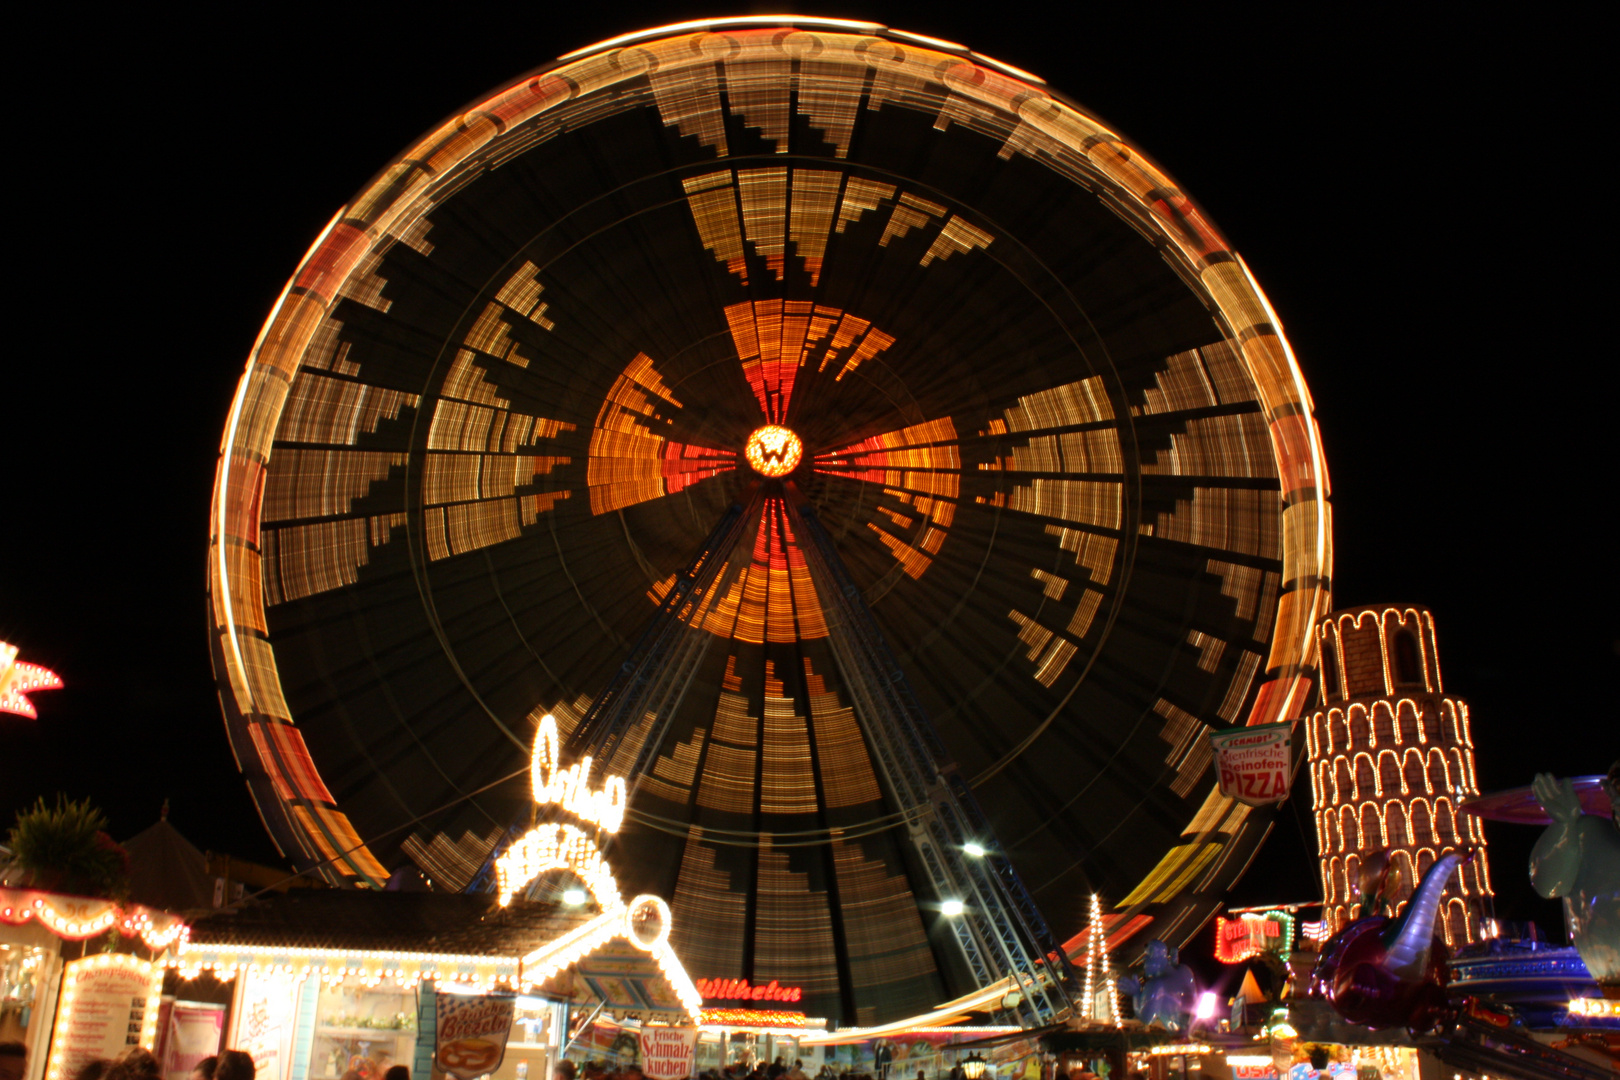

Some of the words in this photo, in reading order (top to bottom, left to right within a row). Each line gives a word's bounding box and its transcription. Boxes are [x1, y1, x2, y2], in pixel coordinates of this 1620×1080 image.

[757, 440, 791, 464] W
[1221, 769, 1286, 799] PIZZA
[441, 1015, 508, 1038] Brezeln
[654, 1030, 684, 1041] Frische
[643, 1035, 693, 1058] Schmalz-
[648, 1058, 687, 1076] kuchen
[1236, 1064, 1278, 1079] USA
